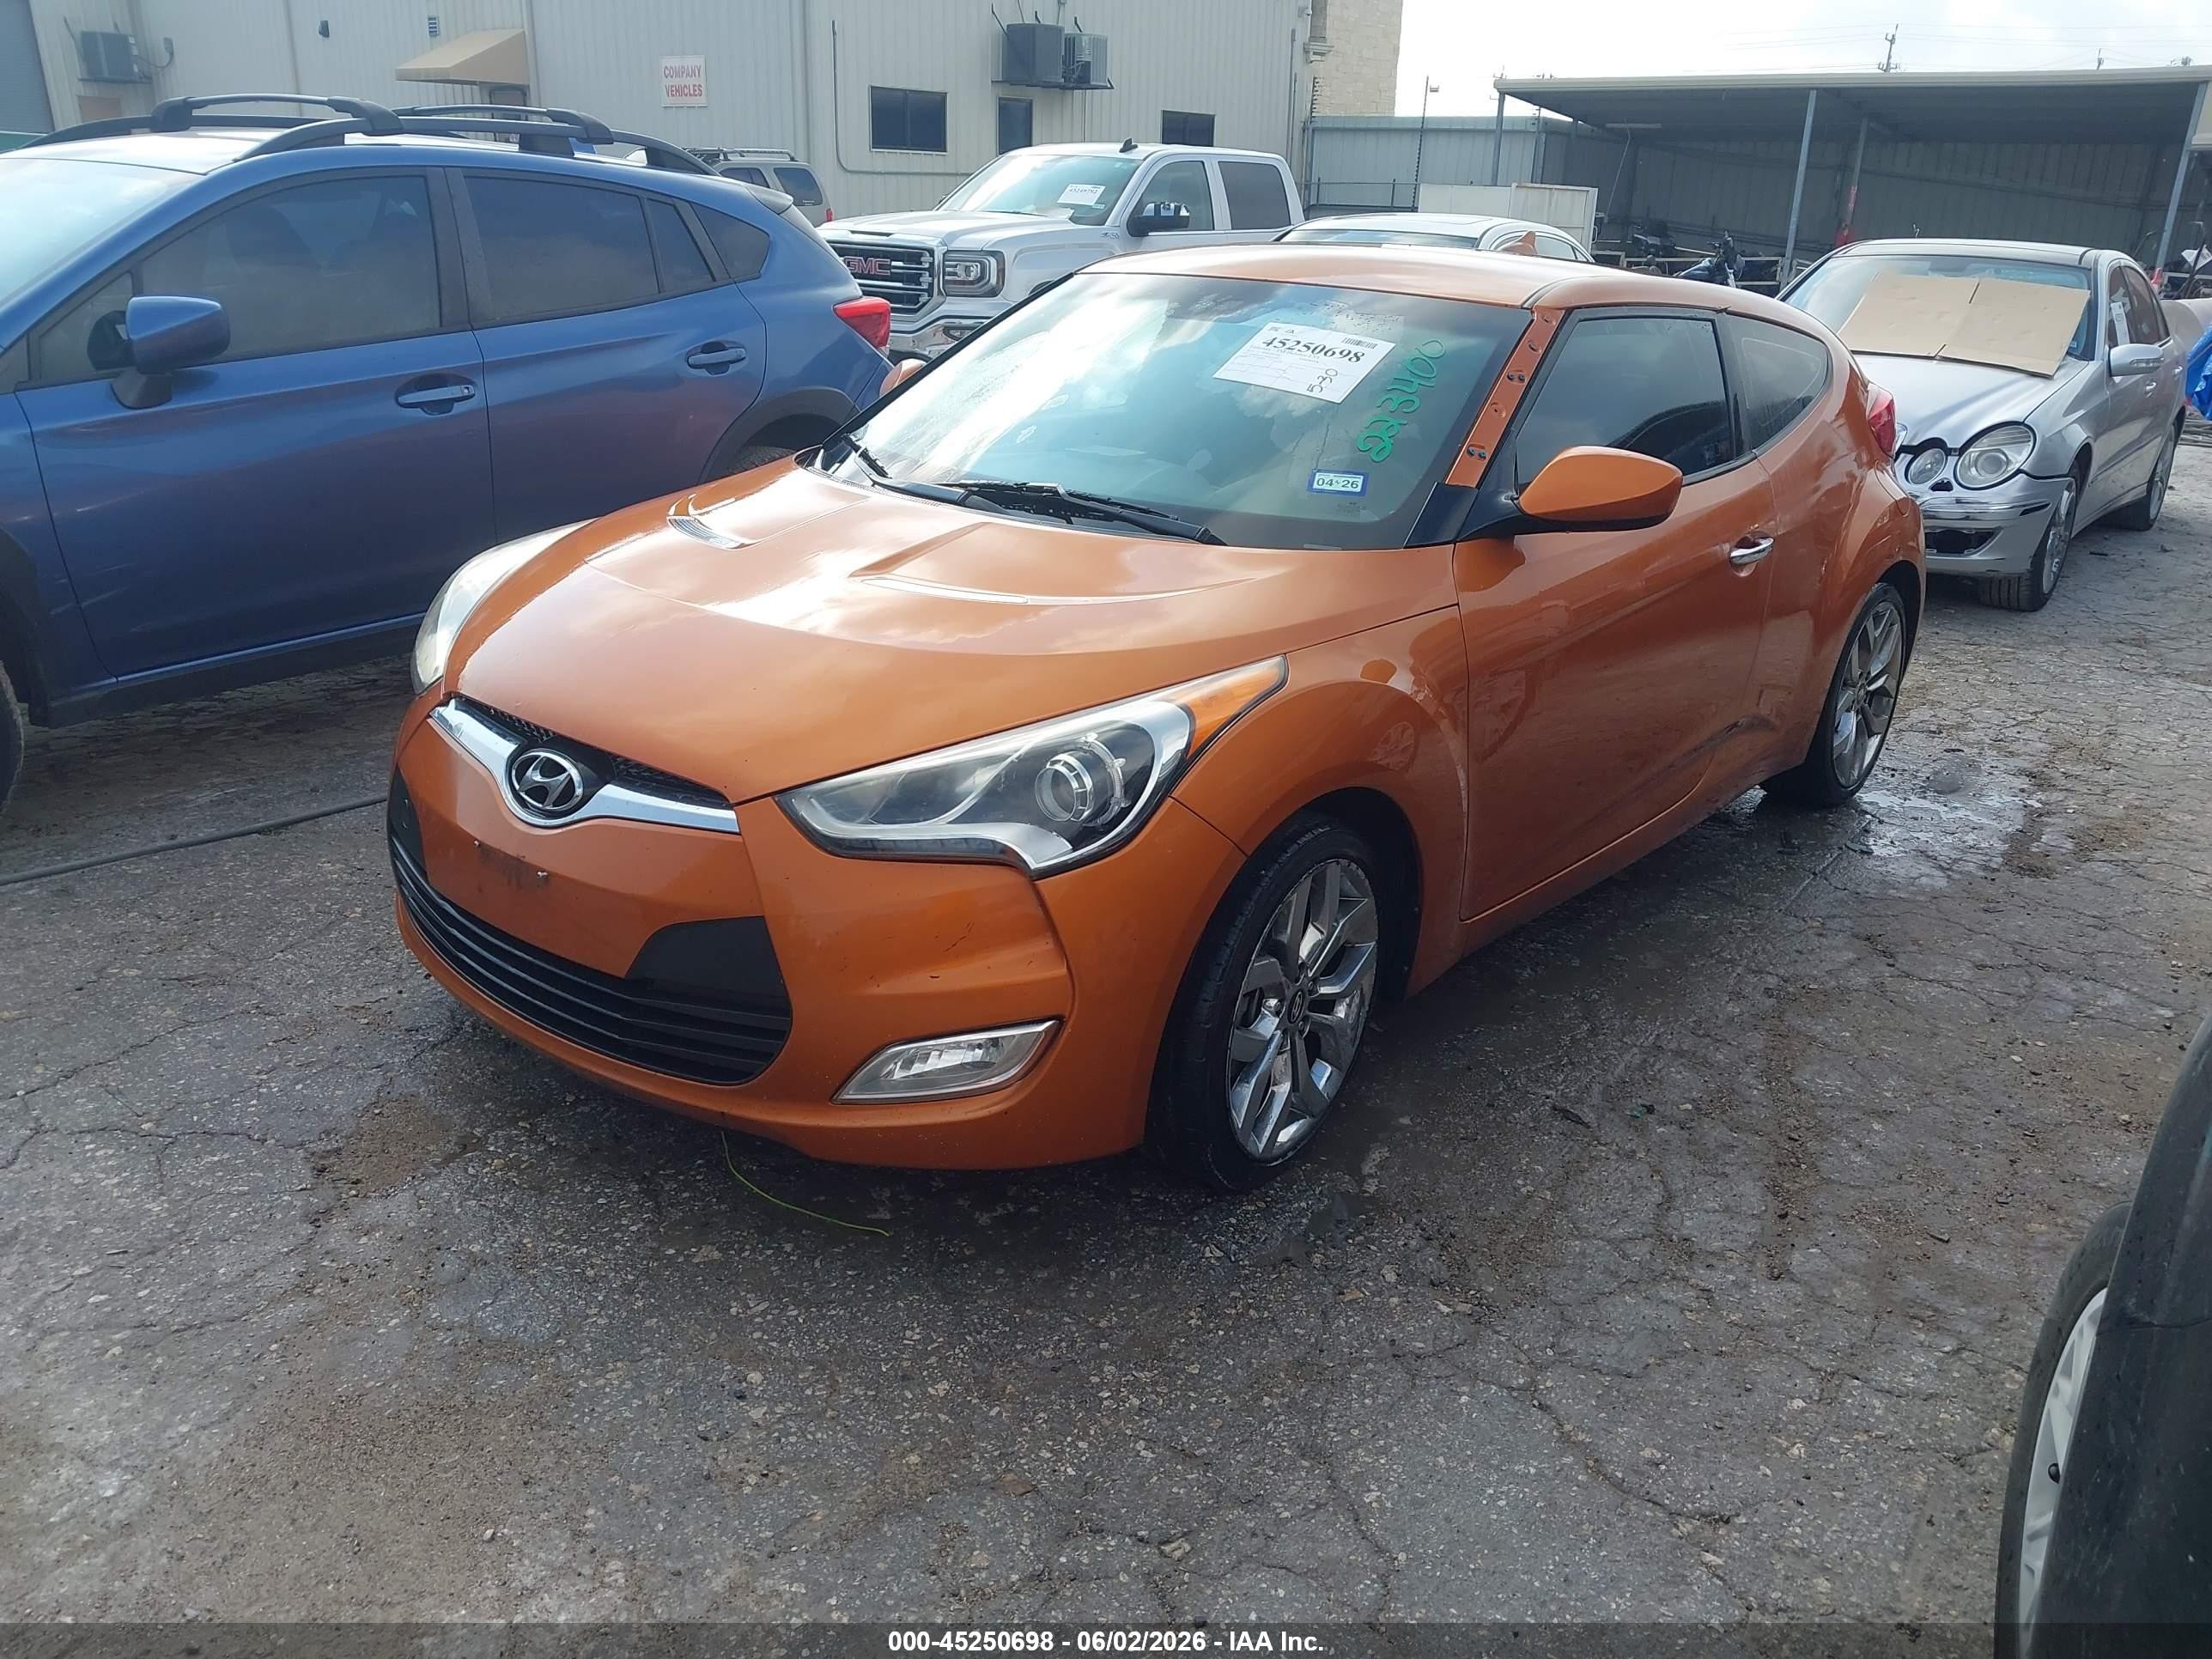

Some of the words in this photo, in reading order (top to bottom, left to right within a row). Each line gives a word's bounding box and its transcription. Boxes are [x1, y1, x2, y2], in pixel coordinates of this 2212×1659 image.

[663, 64, 702, 79] COMPANY
[664, 82, 703, 97] VEHICLES
[844, 256, 890, 276] GMC
[1261, 337, 1365, 363] 45250698
[1340, 478, 1359, 489] 26
